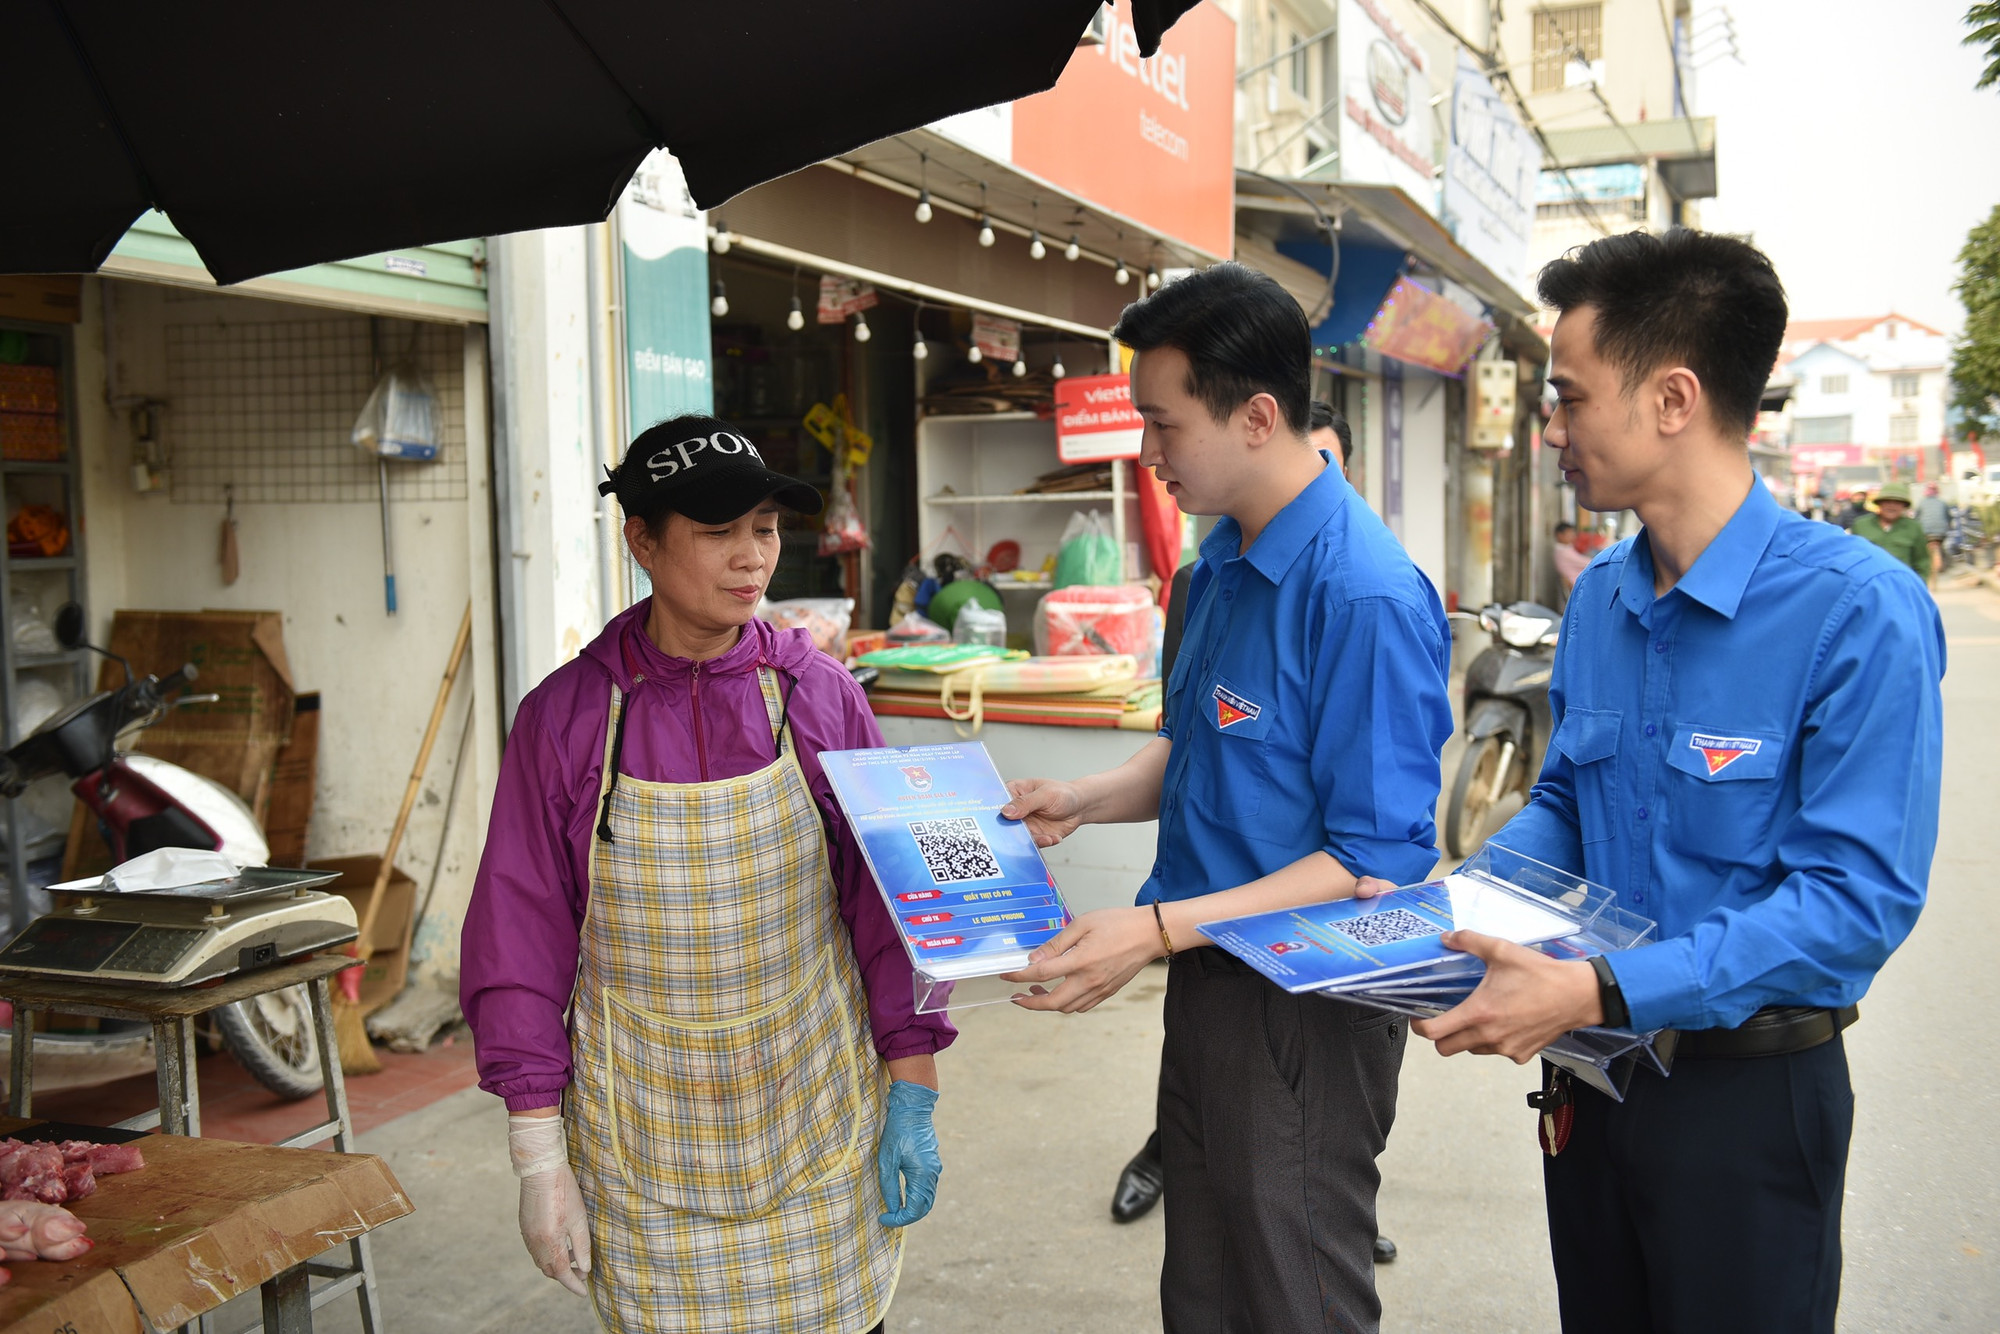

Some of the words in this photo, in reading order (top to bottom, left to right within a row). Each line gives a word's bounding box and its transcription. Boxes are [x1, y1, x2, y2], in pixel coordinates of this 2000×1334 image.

[1140, 108, 1189, 162] telecom
[1083, 385, 1131, 404] viett
[980, 915, 1001, 923] QUANG
